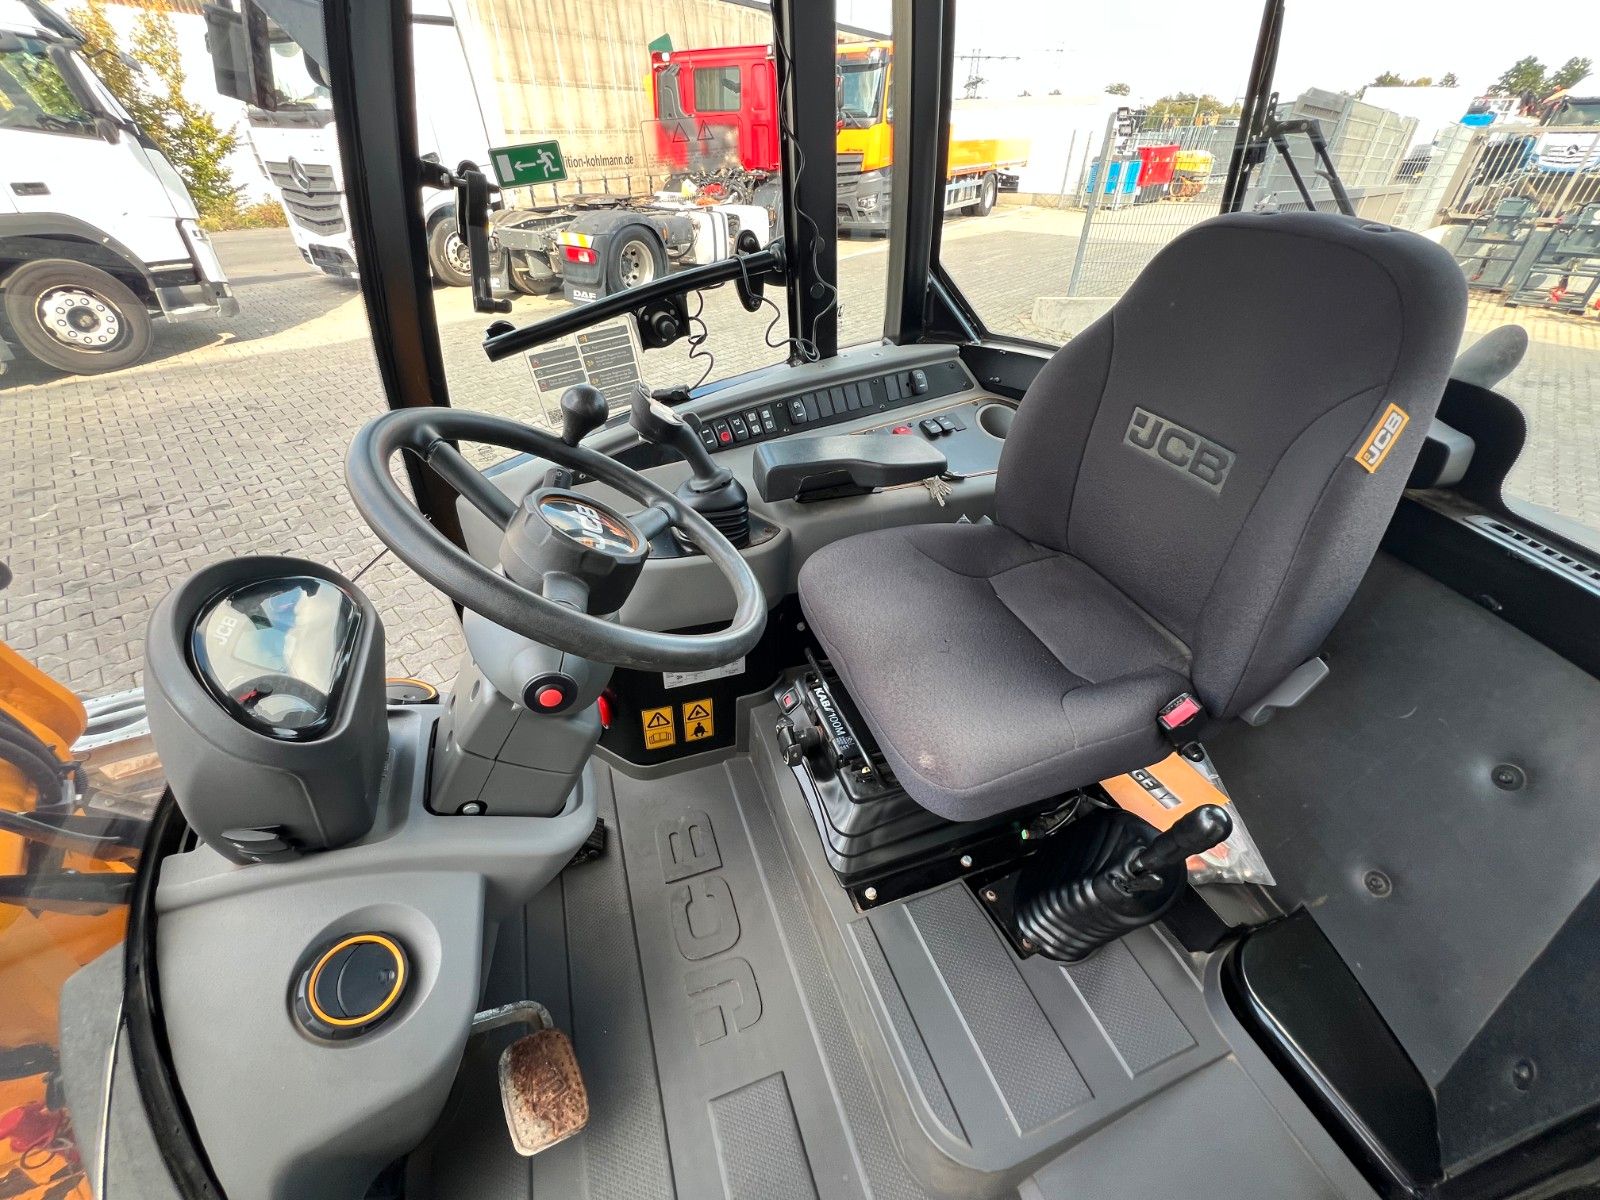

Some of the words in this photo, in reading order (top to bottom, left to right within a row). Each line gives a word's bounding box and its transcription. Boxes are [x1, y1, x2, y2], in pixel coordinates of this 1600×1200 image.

[573, 289, 597, 299] DAF
[1127, 412, 1231, 486] JCB
[1362, 410, 1403, 465] JCB
[576, 503, 606, 550] JCB
[213, 615, 238, 646] JCB
[655, 809, 763, 1046] JCB
